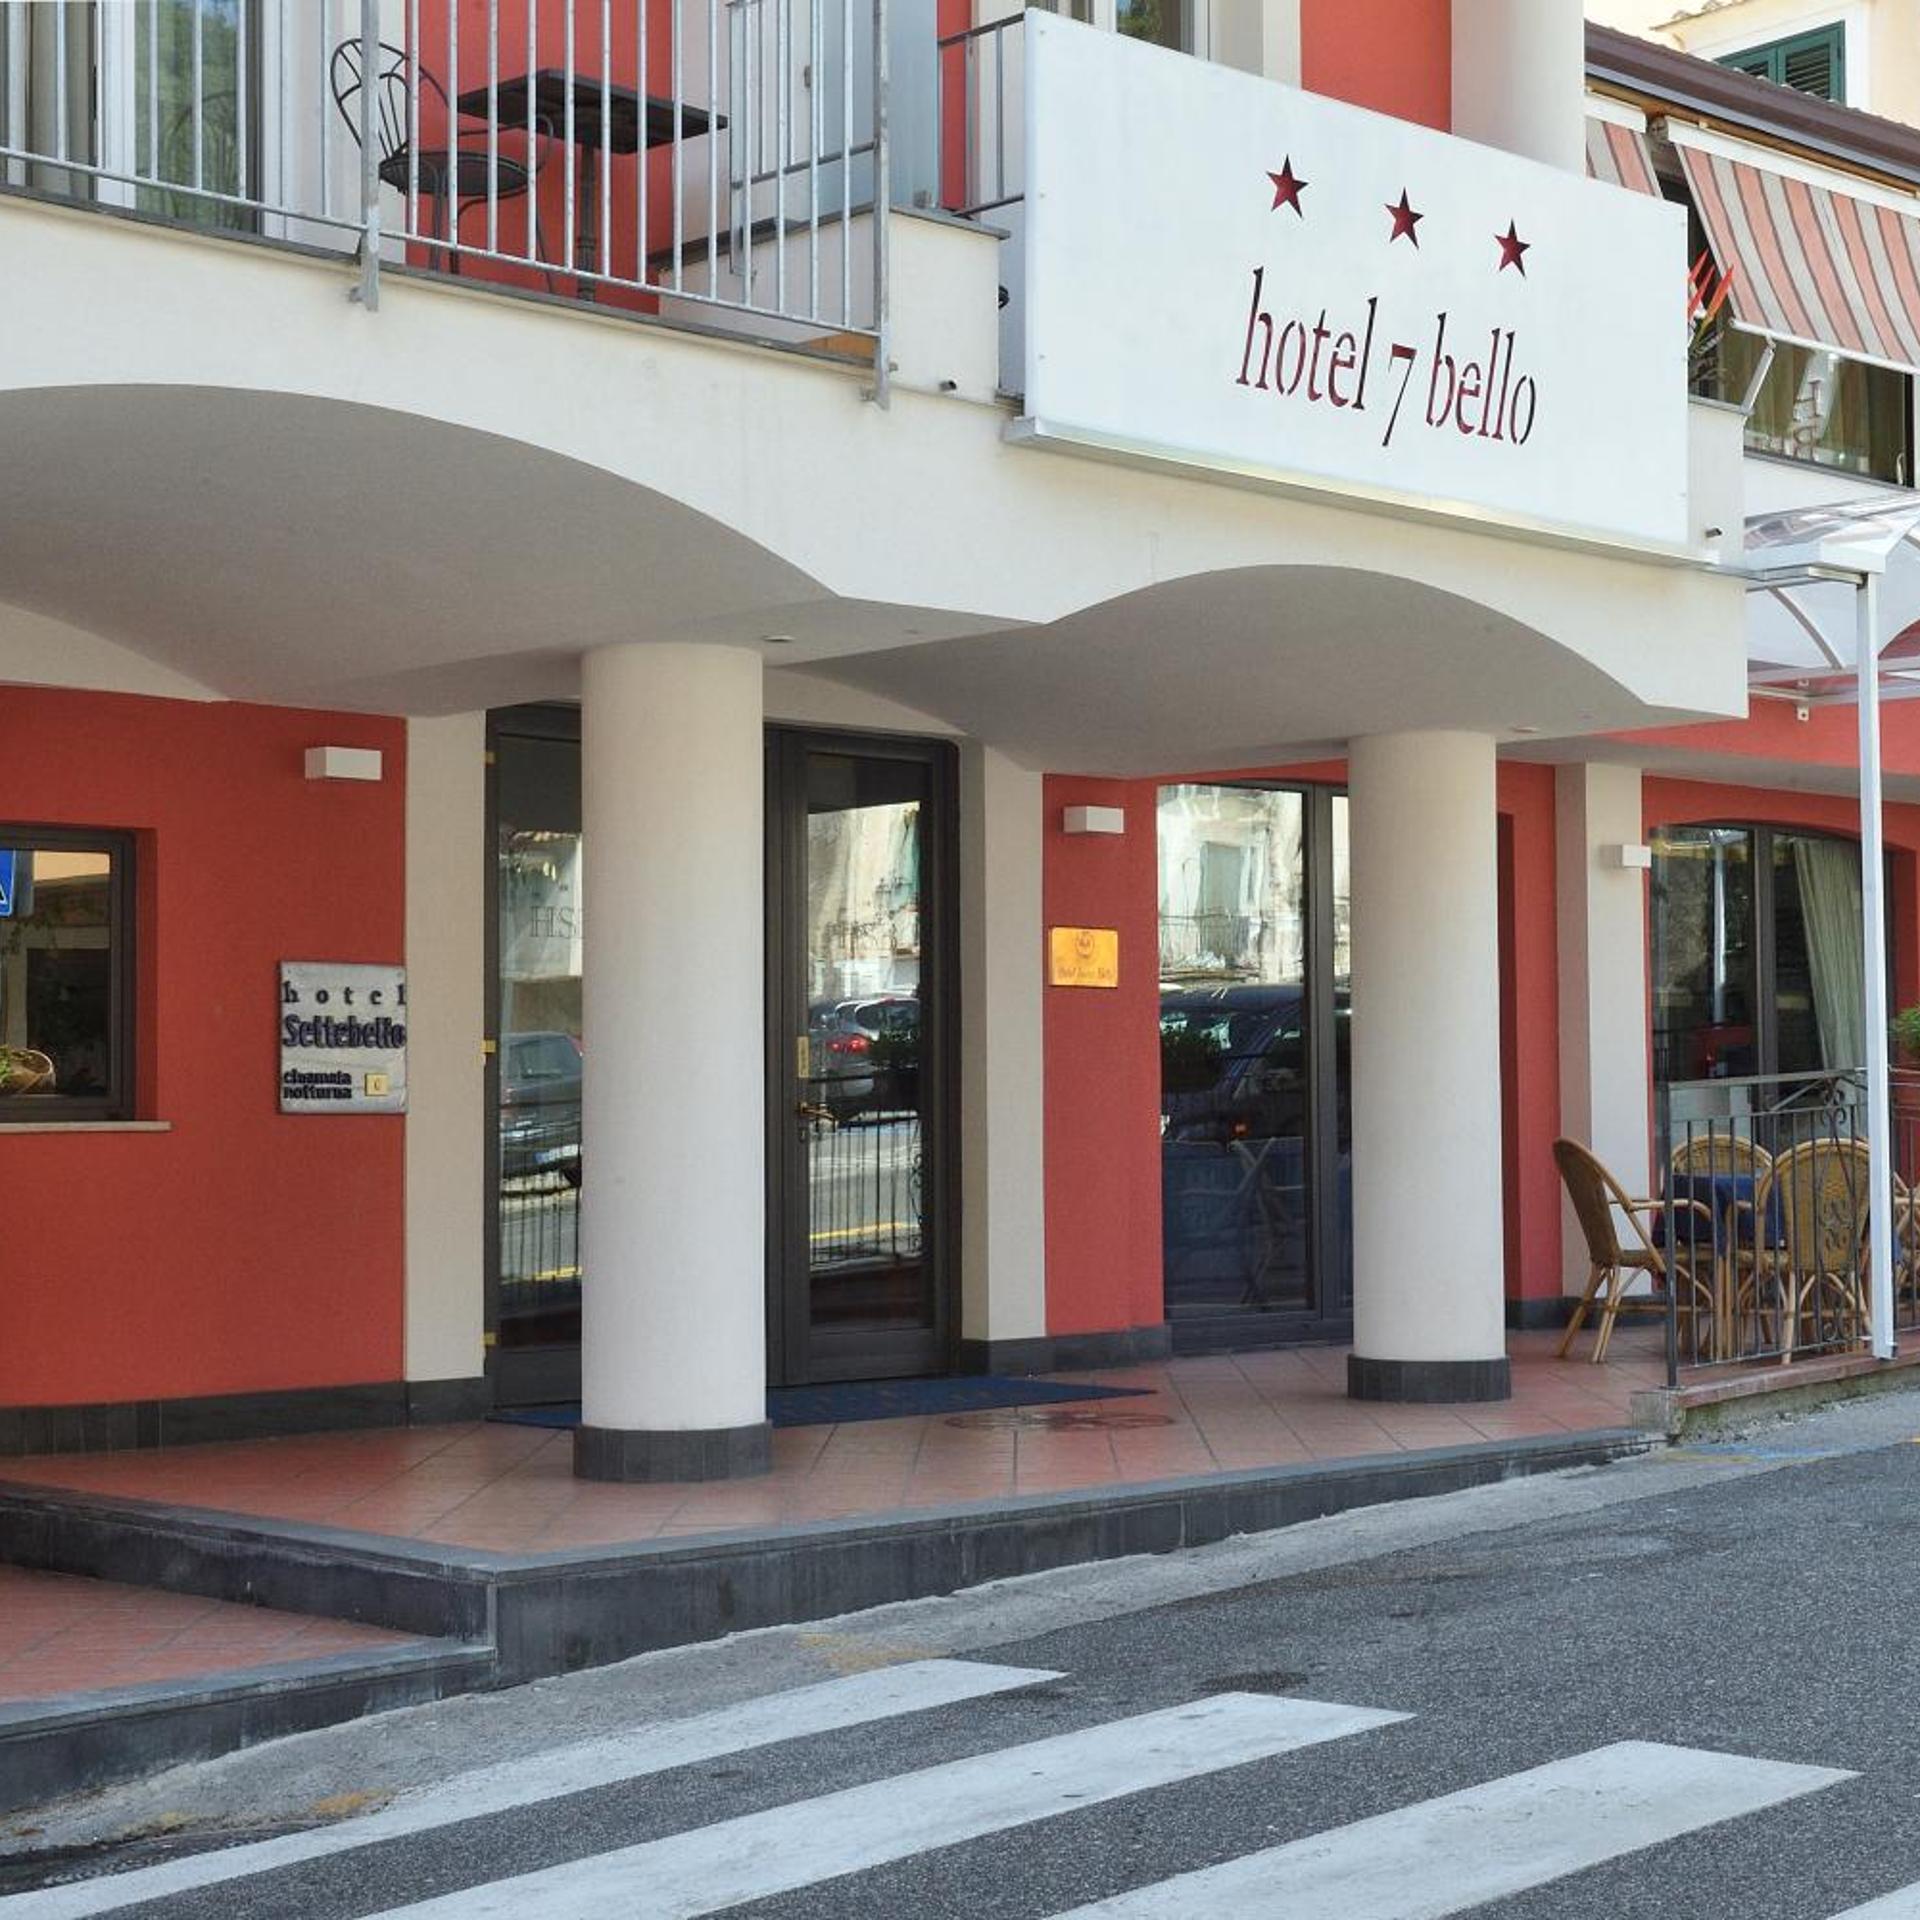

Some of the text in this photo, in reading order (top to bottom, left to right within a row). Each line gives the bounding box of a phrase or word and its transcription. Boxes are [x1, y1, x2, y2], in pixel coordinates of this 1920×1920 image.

[1236, 266, 1536, 447] hotel 7 bello
[283, 1013, 407, 1049] Settebello
